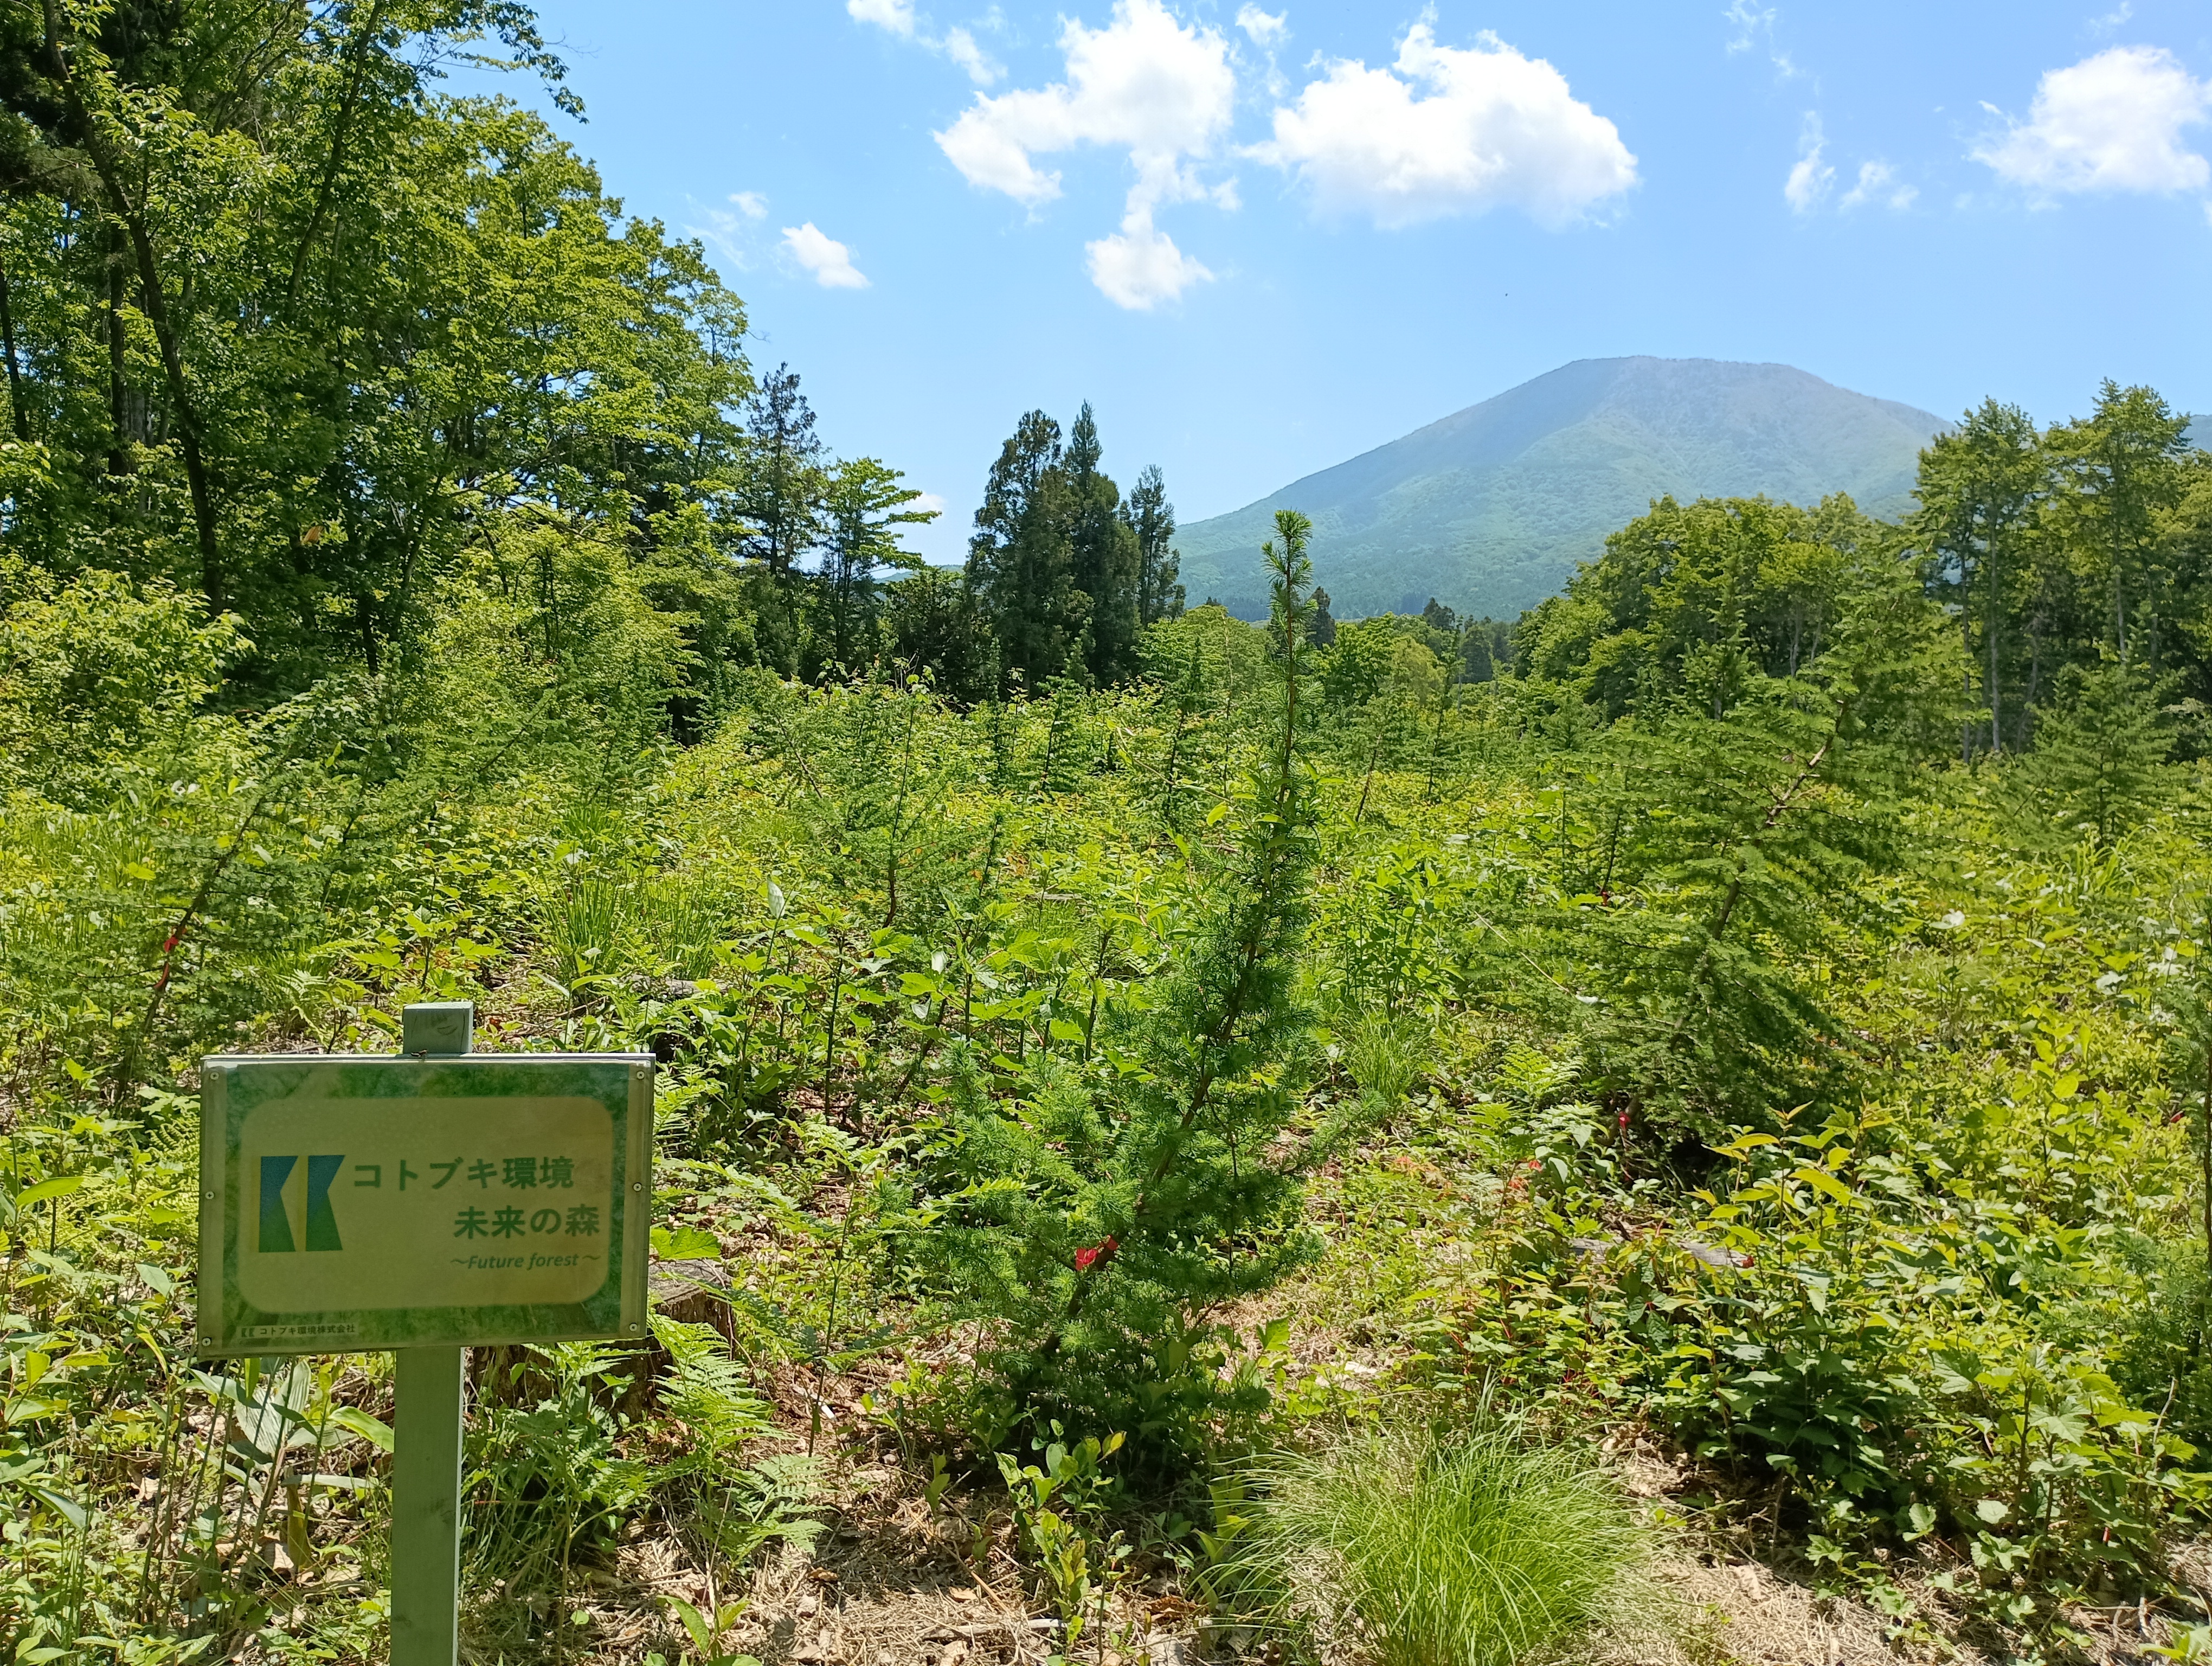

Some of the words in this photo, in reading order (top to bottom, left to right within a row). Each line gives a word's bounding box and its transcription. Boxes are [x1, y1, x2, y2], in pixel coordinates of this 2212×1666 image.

[353, 1156, 575, 1191] コトブキ環境
[453, 1203, 600, 1240] 未来の森
[259, 1324, 356, 1336] コトブキ環境株式会社
